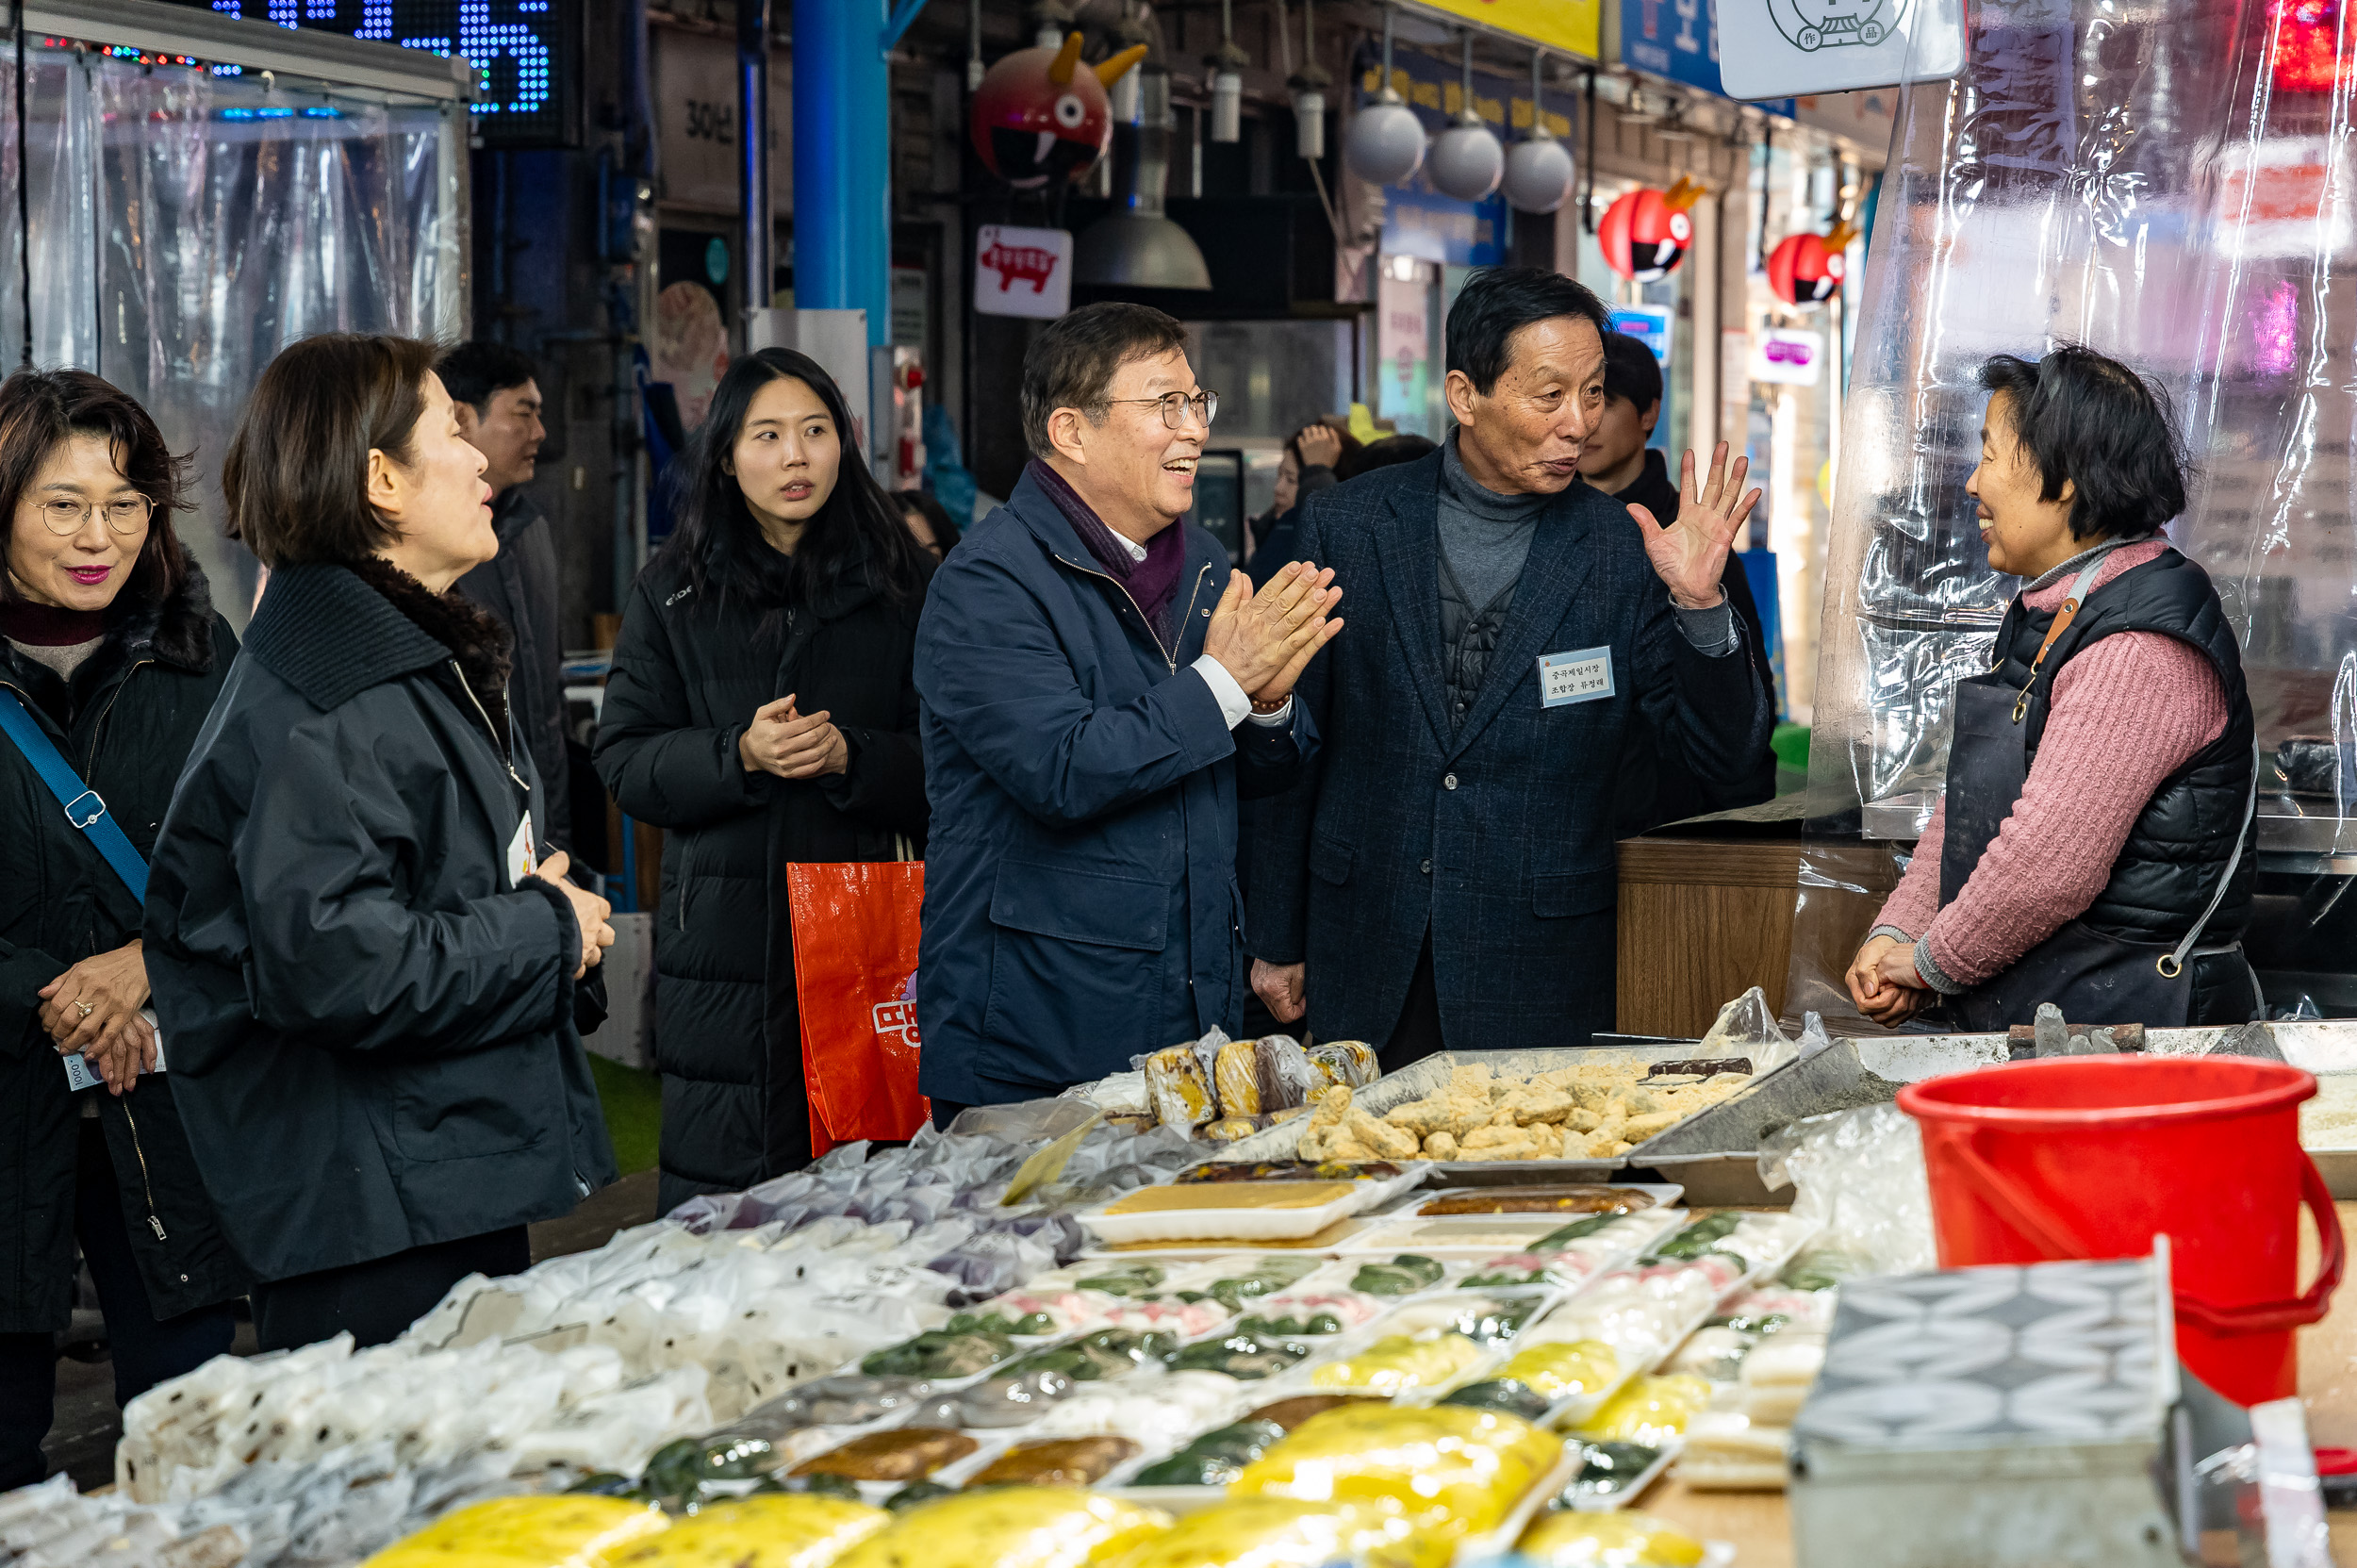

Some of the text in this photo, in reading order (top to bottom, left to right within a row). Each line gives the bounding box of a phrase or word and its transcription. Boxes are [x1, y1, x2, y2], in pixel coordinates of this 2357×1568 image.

[1552, 664, 1600, 681] 중곡제일시장
[1551, 683, 1575, 695] 조합장
[71, 1064, 83, 1086] 1000
